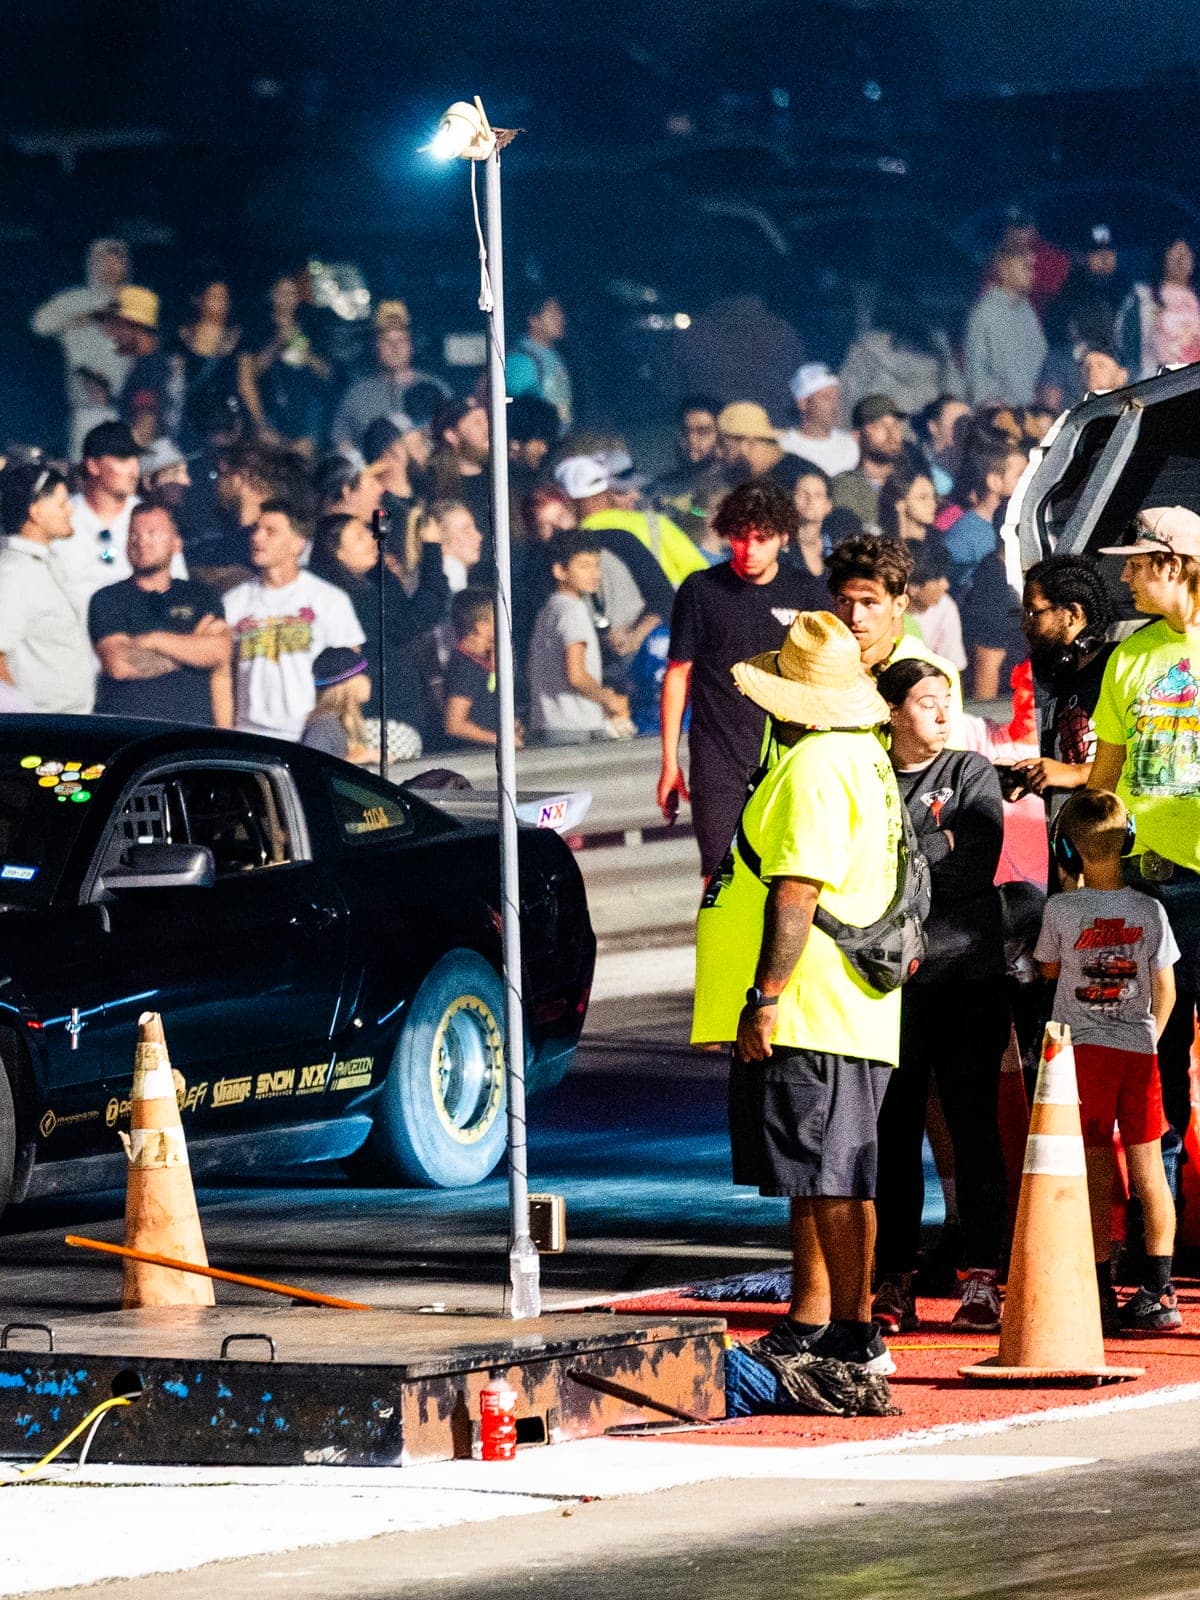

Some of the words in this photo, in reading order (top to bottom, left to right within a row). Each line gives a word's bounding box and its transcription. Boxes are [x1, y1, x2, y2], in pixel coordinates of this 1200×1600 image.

[540, 803, 565, 823] NX
[256, 1069, 295, 1095] SNOW
[298, 1063, 329, 1089] NX
